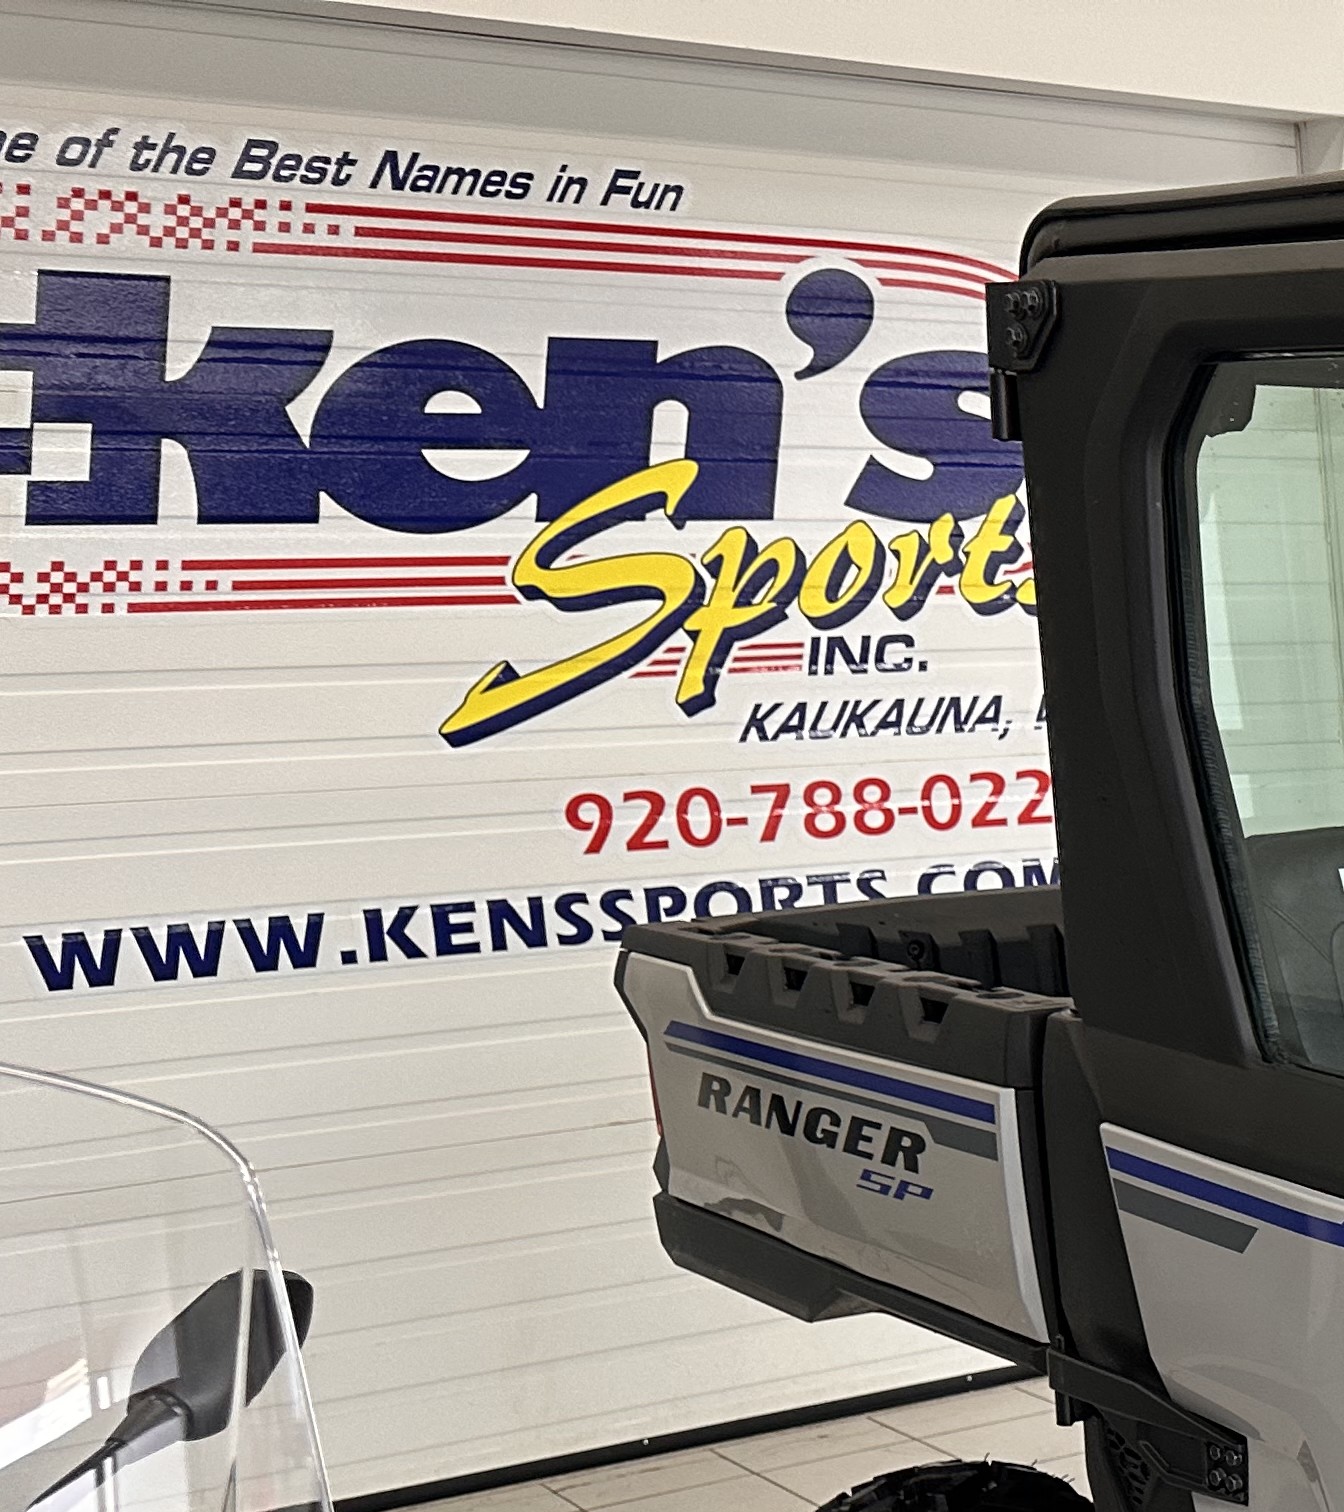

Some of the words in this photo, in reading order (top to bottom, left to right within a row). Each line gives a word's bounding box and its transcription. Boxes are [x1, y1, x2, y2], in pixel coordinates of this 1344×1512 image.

[56, 127, 121, 169] of
[128, 132, 217, 177] the
[230, 138, 358, 188] Best
[368, 149, 535, 200] Names
[546, 164, 588, 204] in
[599, 168, 685, 212] Fun
[438, 457, 1042, 749] Sport
[807, 634, 929, 677] INC.
[738, 694, 1014, 743] KAUKAUNA,
[564, 768, 1054, 855] 920-788-022
[22, 856, 1060, 992] WWW.KENSSPORTSCO
[697, 1072, 927, 1175] RANGER
[856, 1168, 934, 1200] SP
